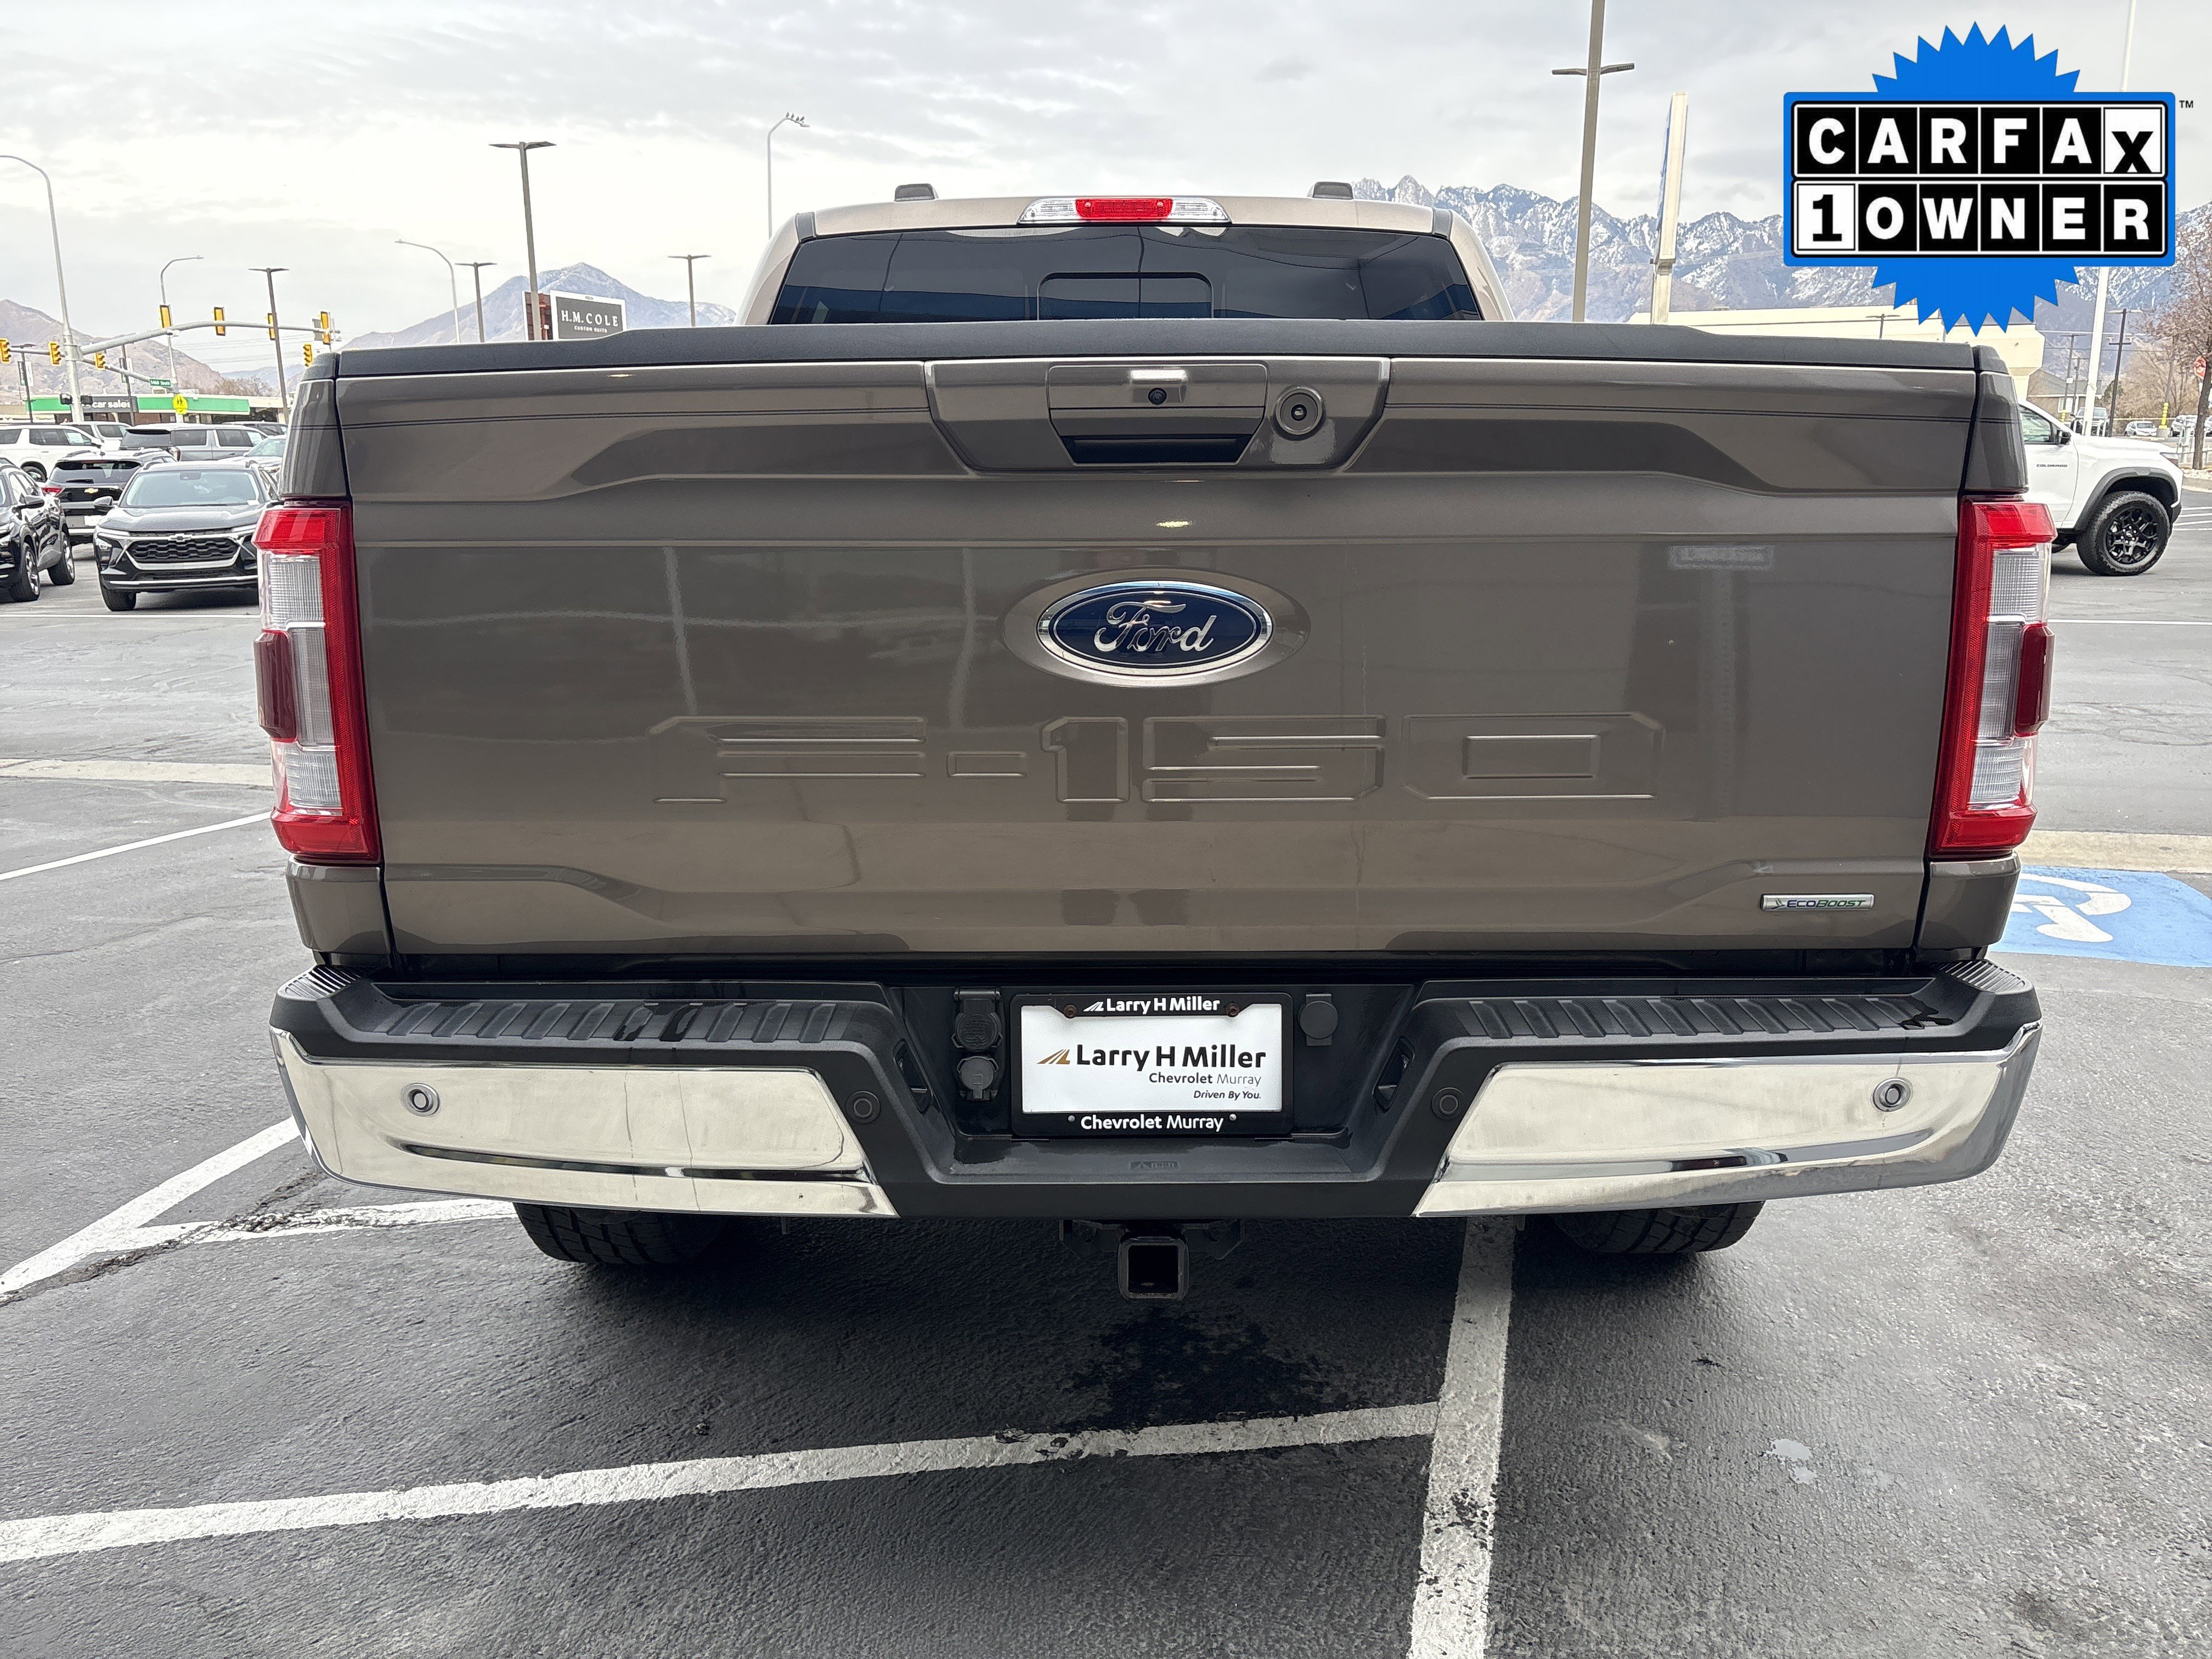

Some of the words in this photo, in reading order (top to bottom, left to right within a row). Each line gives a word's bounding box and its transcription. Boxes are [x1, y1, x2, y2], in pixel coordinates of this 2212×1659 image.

[1093, 601, 1217, 652] Ford
[647, 712, 1666, 803] F-150
[1107, 997, 1151, 1015] Larry
[1154, 997, 1166, 1011] H
[1169, 996, 1220, 1011] Miller
[1077, 1044, 1150, 1071] Larry
[1156, 1046, 1175, 1066] H
[1182, 1044, 1266, 1068] Miller
[1149, 1072, 1213, 1084] Chevrolet
[1217, 1074, 1262, 1087] Murray
[1193, 1090, 1225, 1099] Driven
[1228, 1091, 1240, 1101] By
[1242, 1091, 1261, 1099] You.
[1081, 1114, 1163, 1130] Chevrolet
[1166, 1115, 1224, 1132] Murray
